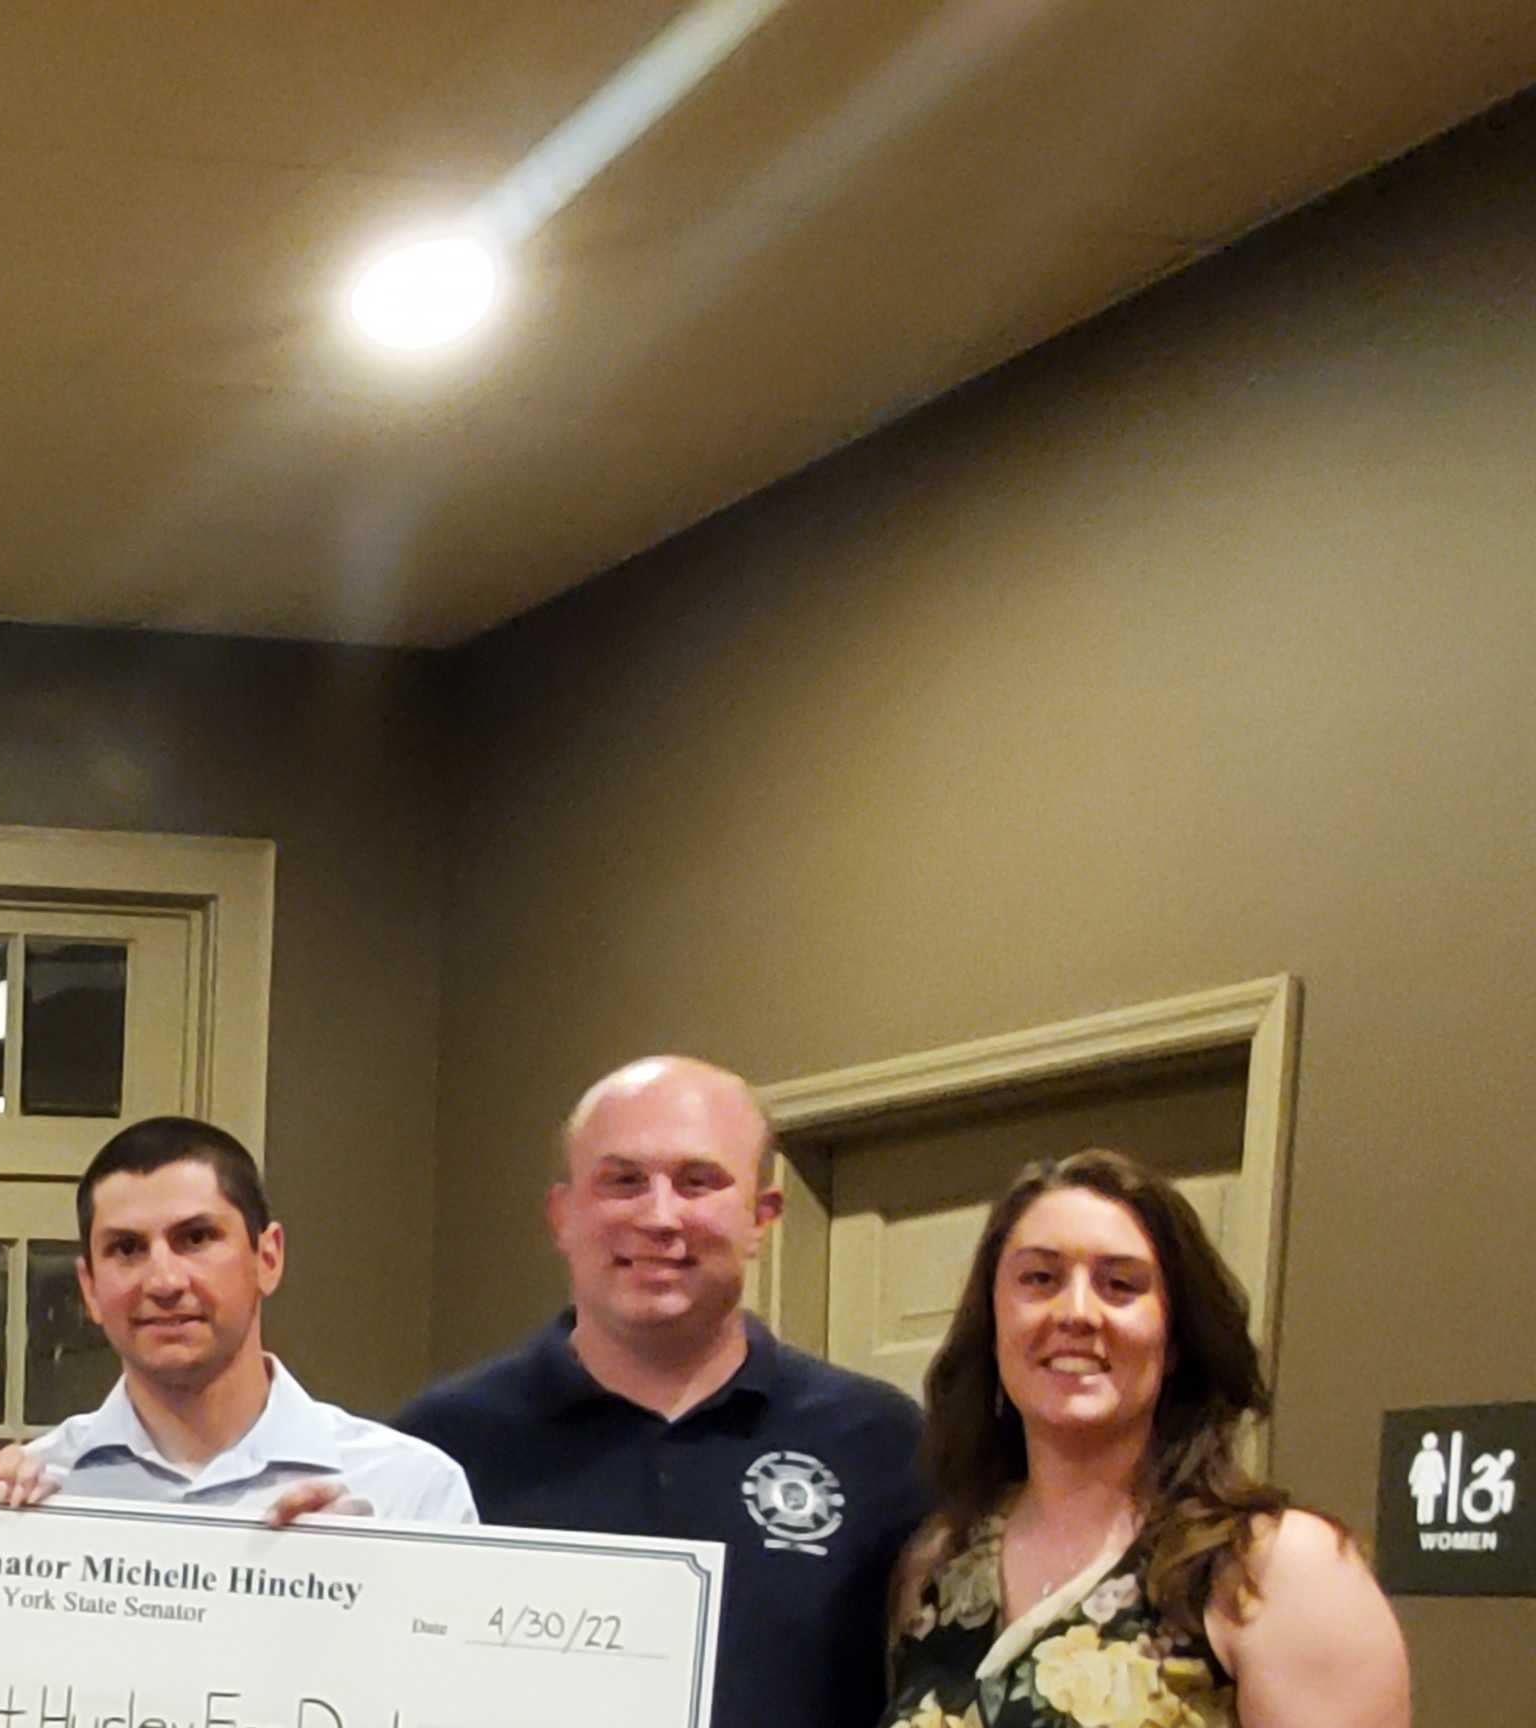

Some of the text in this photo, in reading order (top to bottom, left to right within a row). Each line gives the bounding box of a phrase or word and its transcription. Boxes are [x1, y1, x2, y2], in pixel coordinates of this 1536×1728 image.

[1419, 1531, 1498, 1551] WOMEN
[81, 1555, 217, 1592] Michelle
[228, 1566, 363, 1609] Hinchey
[3, 1587, 56, 1611] York
[64, 1593, 117, 1615] State
[124, 1598, 207, 1623] Senator
[412, 1618, 448, 1636] Date
[488, 1605, 624, 1653] 4/30/22
